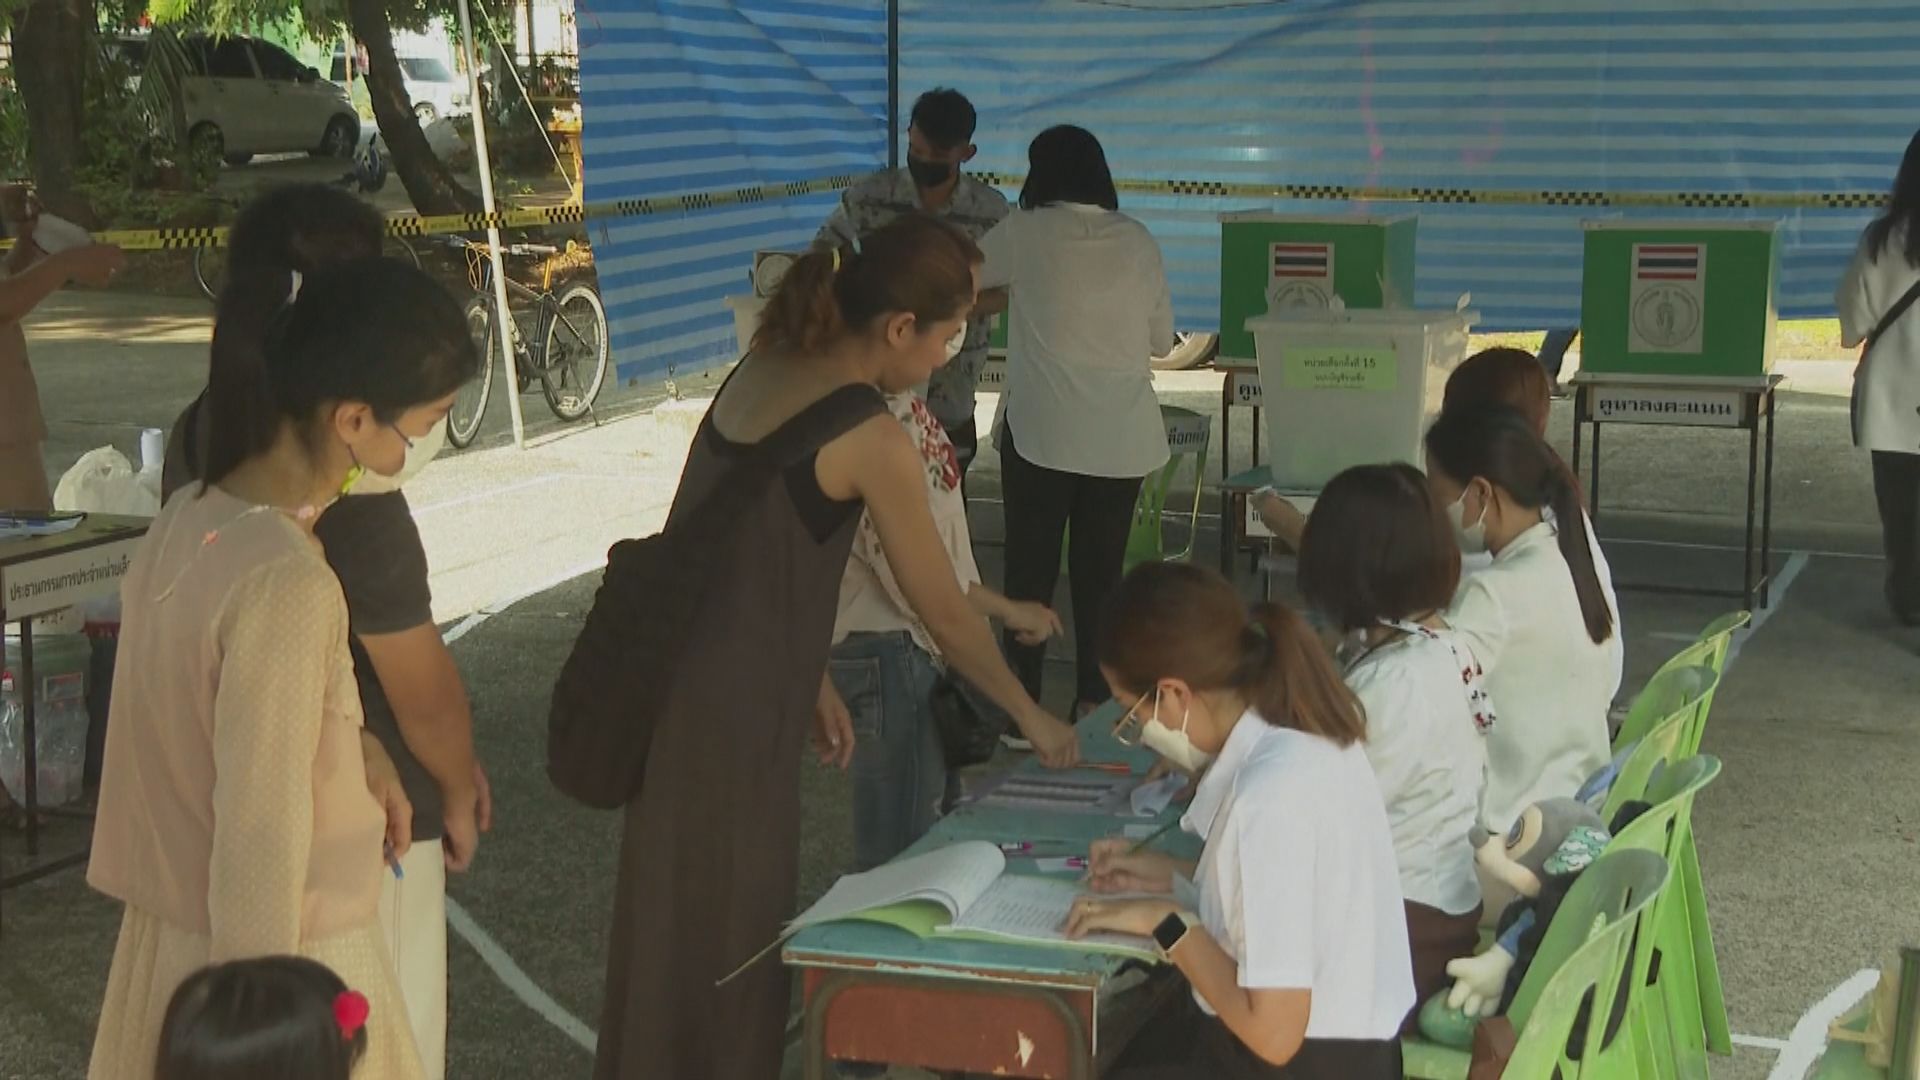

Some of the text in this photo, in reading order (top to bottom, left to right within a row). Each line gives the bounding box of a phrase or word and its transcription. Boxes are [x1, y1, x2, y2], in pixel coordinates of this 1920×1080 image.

[1363, 357, 1377, 368] 15
[1599, 399, 1732, 416] คูหาลงคะแนน
